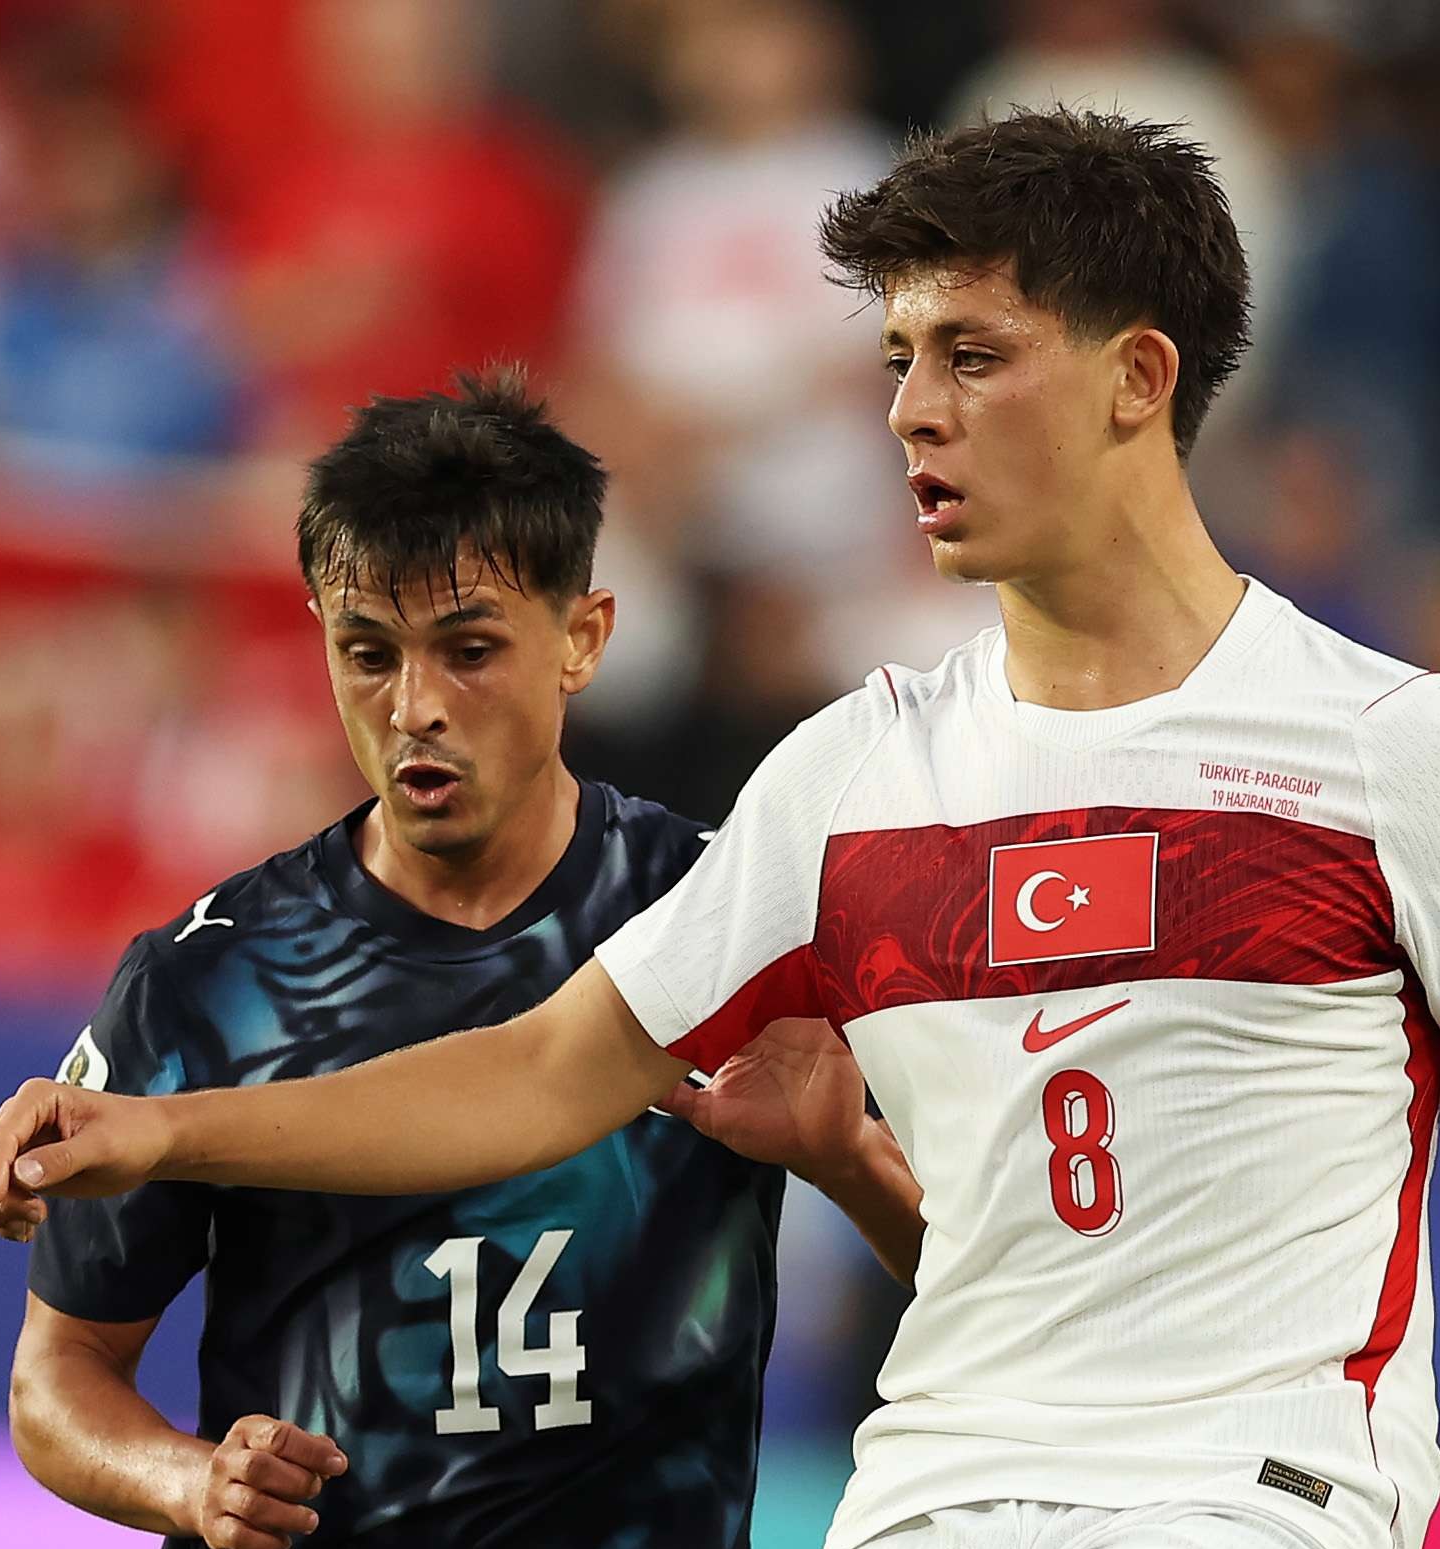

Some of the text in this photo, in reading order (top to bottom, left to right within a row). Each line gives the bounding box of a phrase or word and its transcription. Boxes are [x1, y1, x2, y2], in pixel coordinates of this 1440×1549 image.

[1199, 761, 1322, 797] TÜRKİYE-PARAGUAY
[1212, 789, 1300, 818] 19 HAZİRAN 2026
[1042, 1069, 1124, 1238] 8
[423, 1230, 592, 1434] 14
